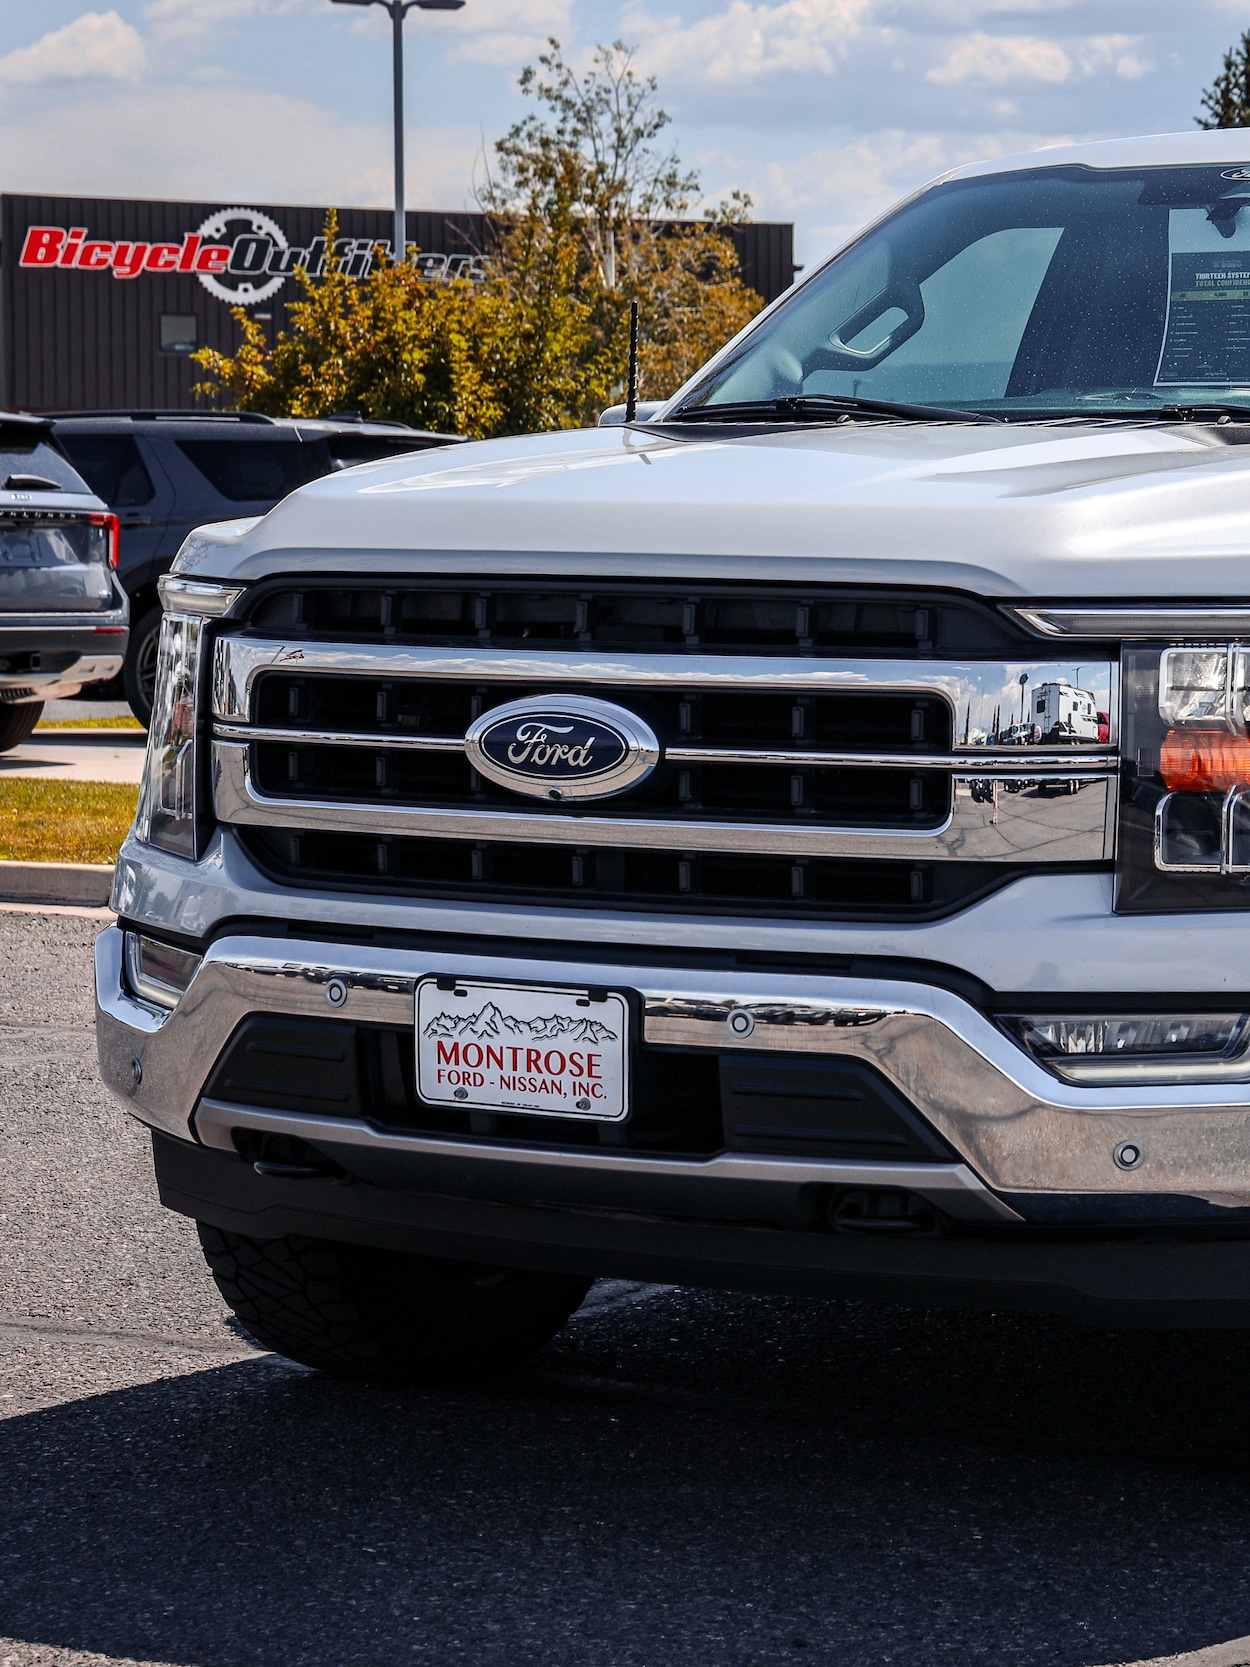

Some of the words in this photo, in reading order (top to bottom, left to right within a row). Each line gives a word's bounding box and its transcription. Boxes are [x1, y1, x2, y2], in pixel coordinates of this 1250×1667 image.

[20, 226, 231, 279] Bicycle
[227, 233, 494, 283] Outfiters
[1195, 272, 1227, 280] THIRTEEN
[507, 722, 596, 767] Ford
[436, 1040, 603, 1080] MONTROSE
[436, 1069, 485, 1088] FORD
[500, 1075, 568, 1098] NISSAN,
[572, 1081, 608, 1100] INC.
